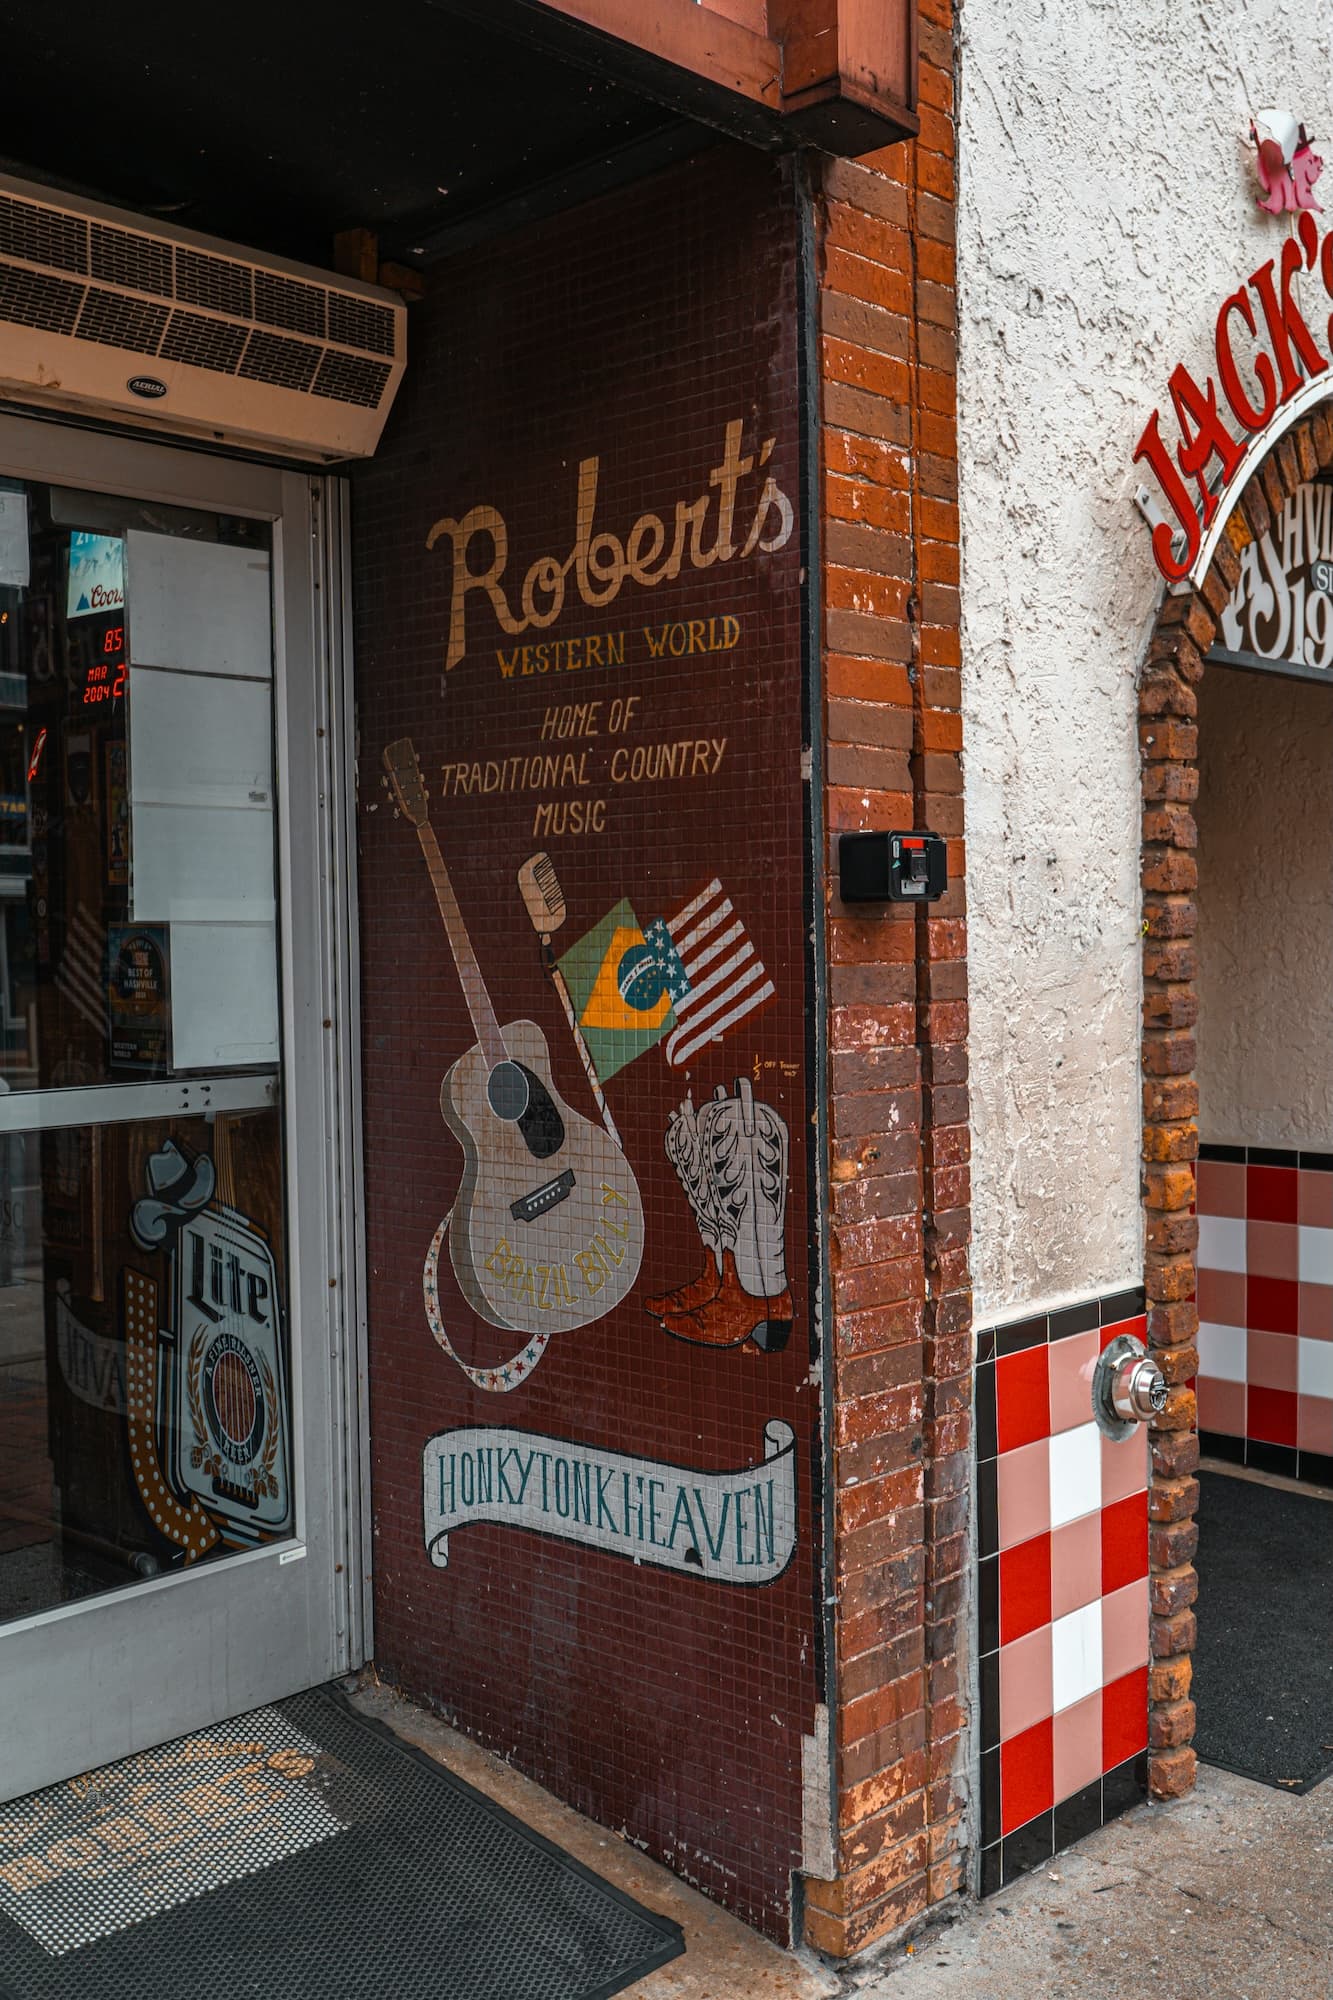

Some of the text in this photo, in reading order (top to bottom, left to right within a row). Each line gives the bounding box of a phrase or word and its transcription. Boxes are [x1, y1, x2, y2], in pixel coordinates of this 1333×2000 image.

[425, 418, 795, 672] Robert's
[1221, 483, 1333, 661] ASHVI
[87, 665, 108, 682] MAR
[496, 615, 741, 679] WESTERN WORLD
[83, 685, 110, 703] 2004
[541, 697, 641, 740] HOME OF
[440, 737, 728, 797] TRADITIONAL COUNTRY
[532, 800, 607, 837] MUSIC
[186, 1229, 268, 1325] Lite
[484, 1182, 630, 1310] BRAZIL BILLY
